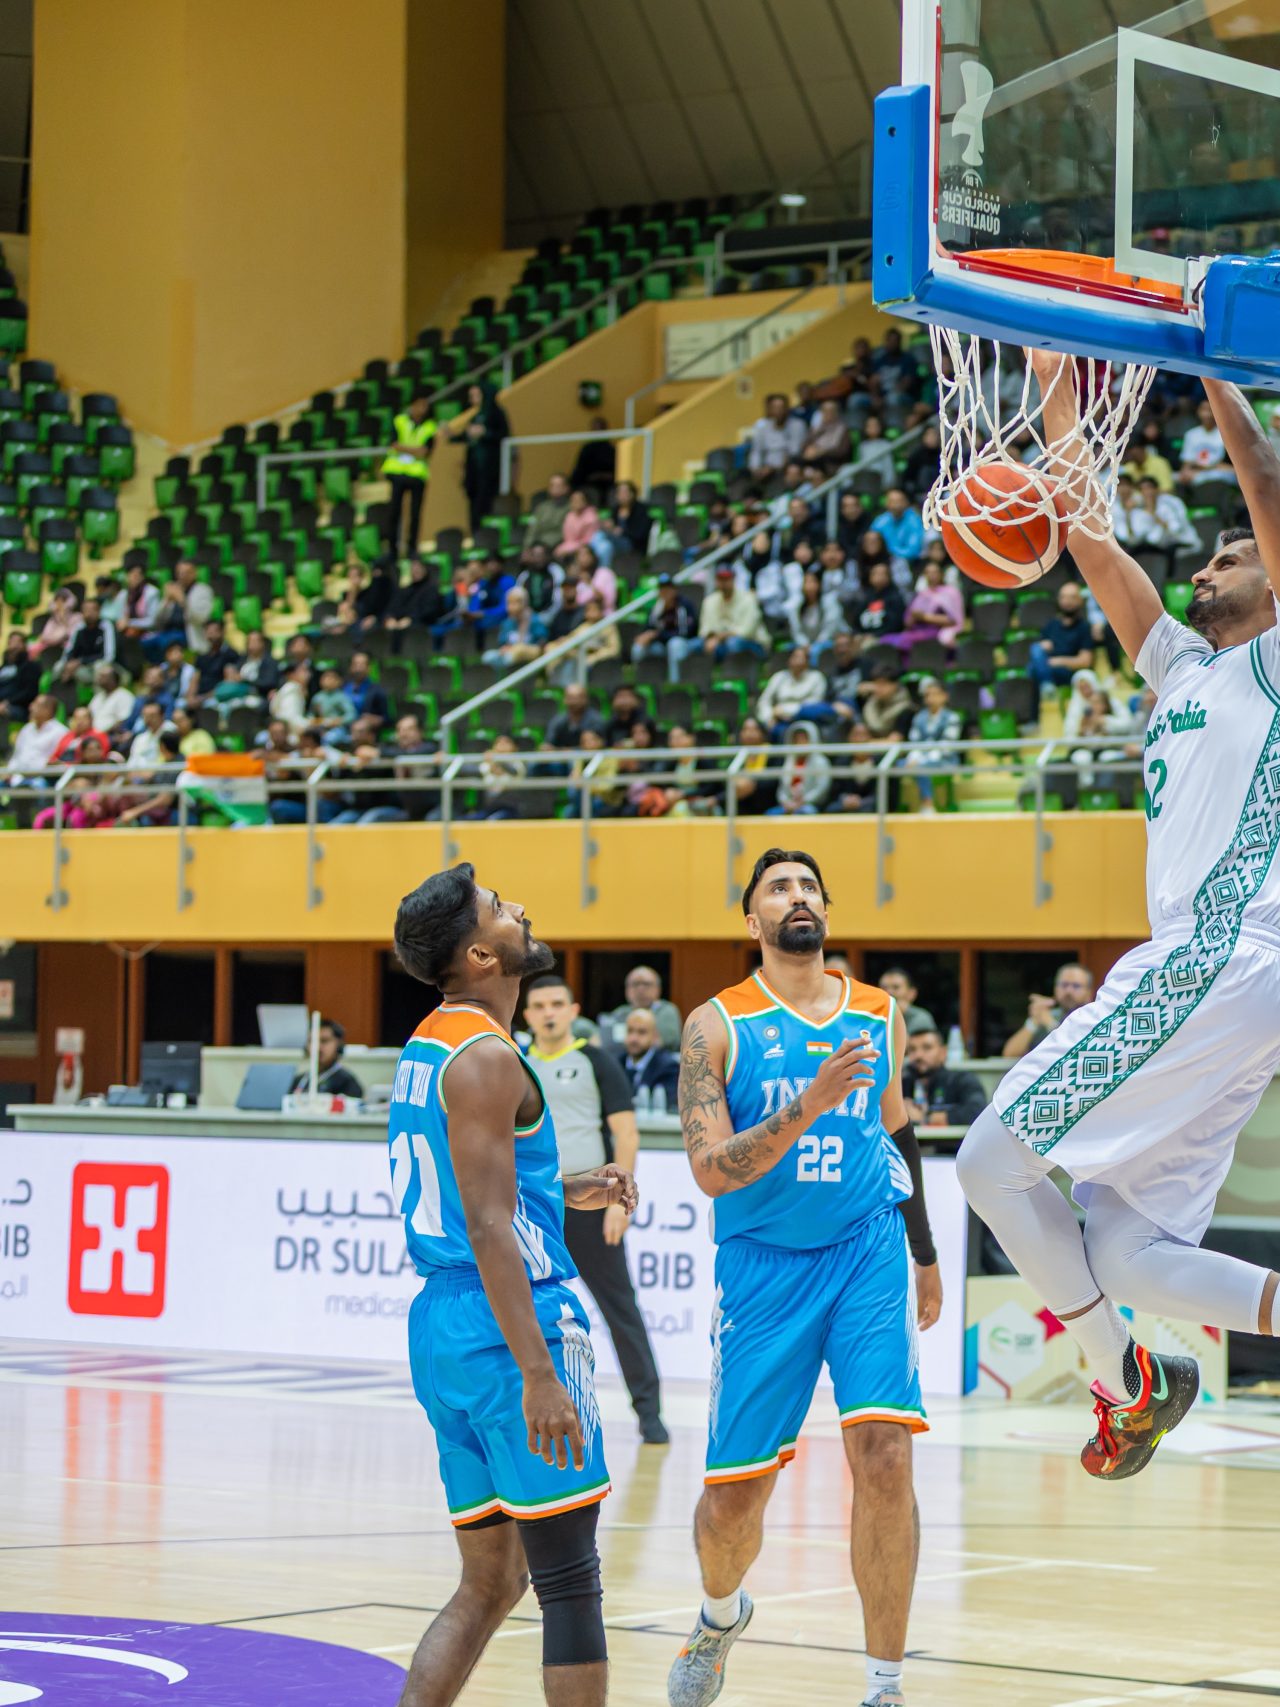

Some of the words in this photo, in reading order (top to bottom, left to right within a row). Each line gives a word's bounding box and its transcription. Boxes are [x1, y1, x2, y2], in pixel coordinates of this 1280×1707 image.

[796, 1135, 843, 1182] 22
[275, 1236, 320, 1272] DR
[333, 1238, 419, 1277] SULA
[638, 1251, 695, 1290] BIB
[325, 1292, 409, 1317] medica
